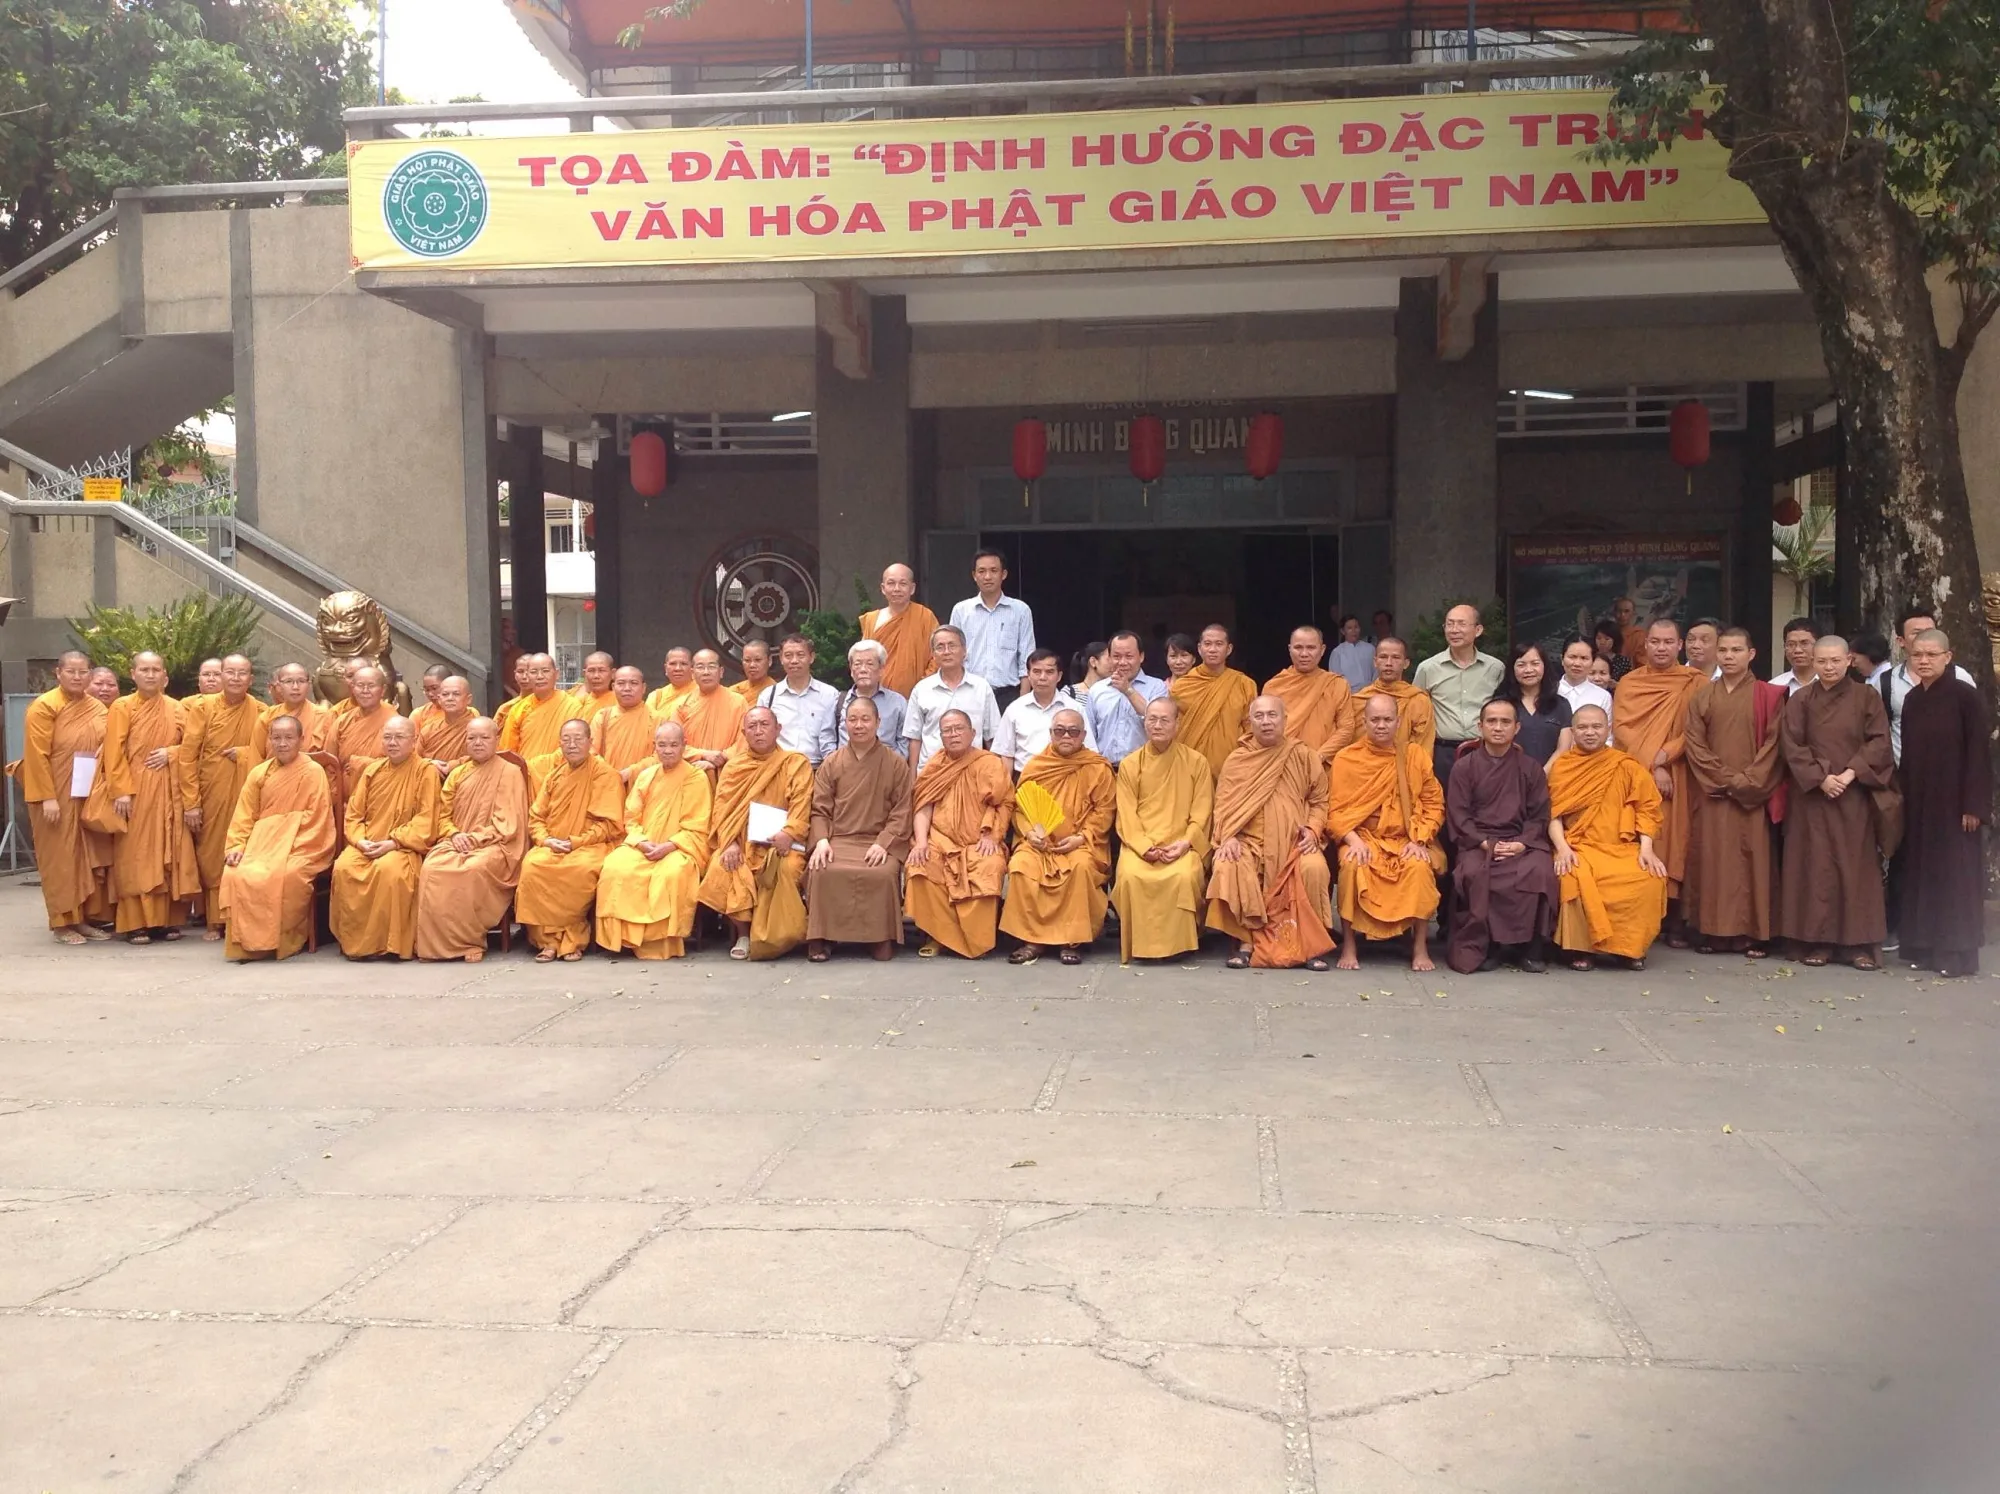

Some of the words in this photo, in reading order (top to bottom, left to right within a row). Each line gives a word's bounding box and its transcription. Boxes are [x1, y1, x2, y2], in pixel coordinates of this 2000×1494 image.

[518, 154, 649, 195] TỌA
[668, 140, 830, 182] ĐÀM:
[1071, 120, 1315, 167] HƯỚNG
[1338, 111, 1485, 162] ĐẶC
[391, 174, 408, 204] GIÁO
[406, 159, 428, 176] HỘI
[430, 157, 463, 174] PHẬT
[462, 172, 480, 201] GIÁO
[590, 200, 724, 241] VĂN
[749, 194, 886, 237] HÓA
[908, 188, 1086, 238] PHẬT
[1108, 178, 1277, 224] GIÁO
[1300, 171, 1463, 222] VIỆT
[1489, 168, 1679, 208] NAM”
[409, 234, 437, 251] VIỆT
[438, 234, 464, 251] NAM
[1046, 420, 1104, 452] MINH
[1114, 418, 1180, 450] ĐG
